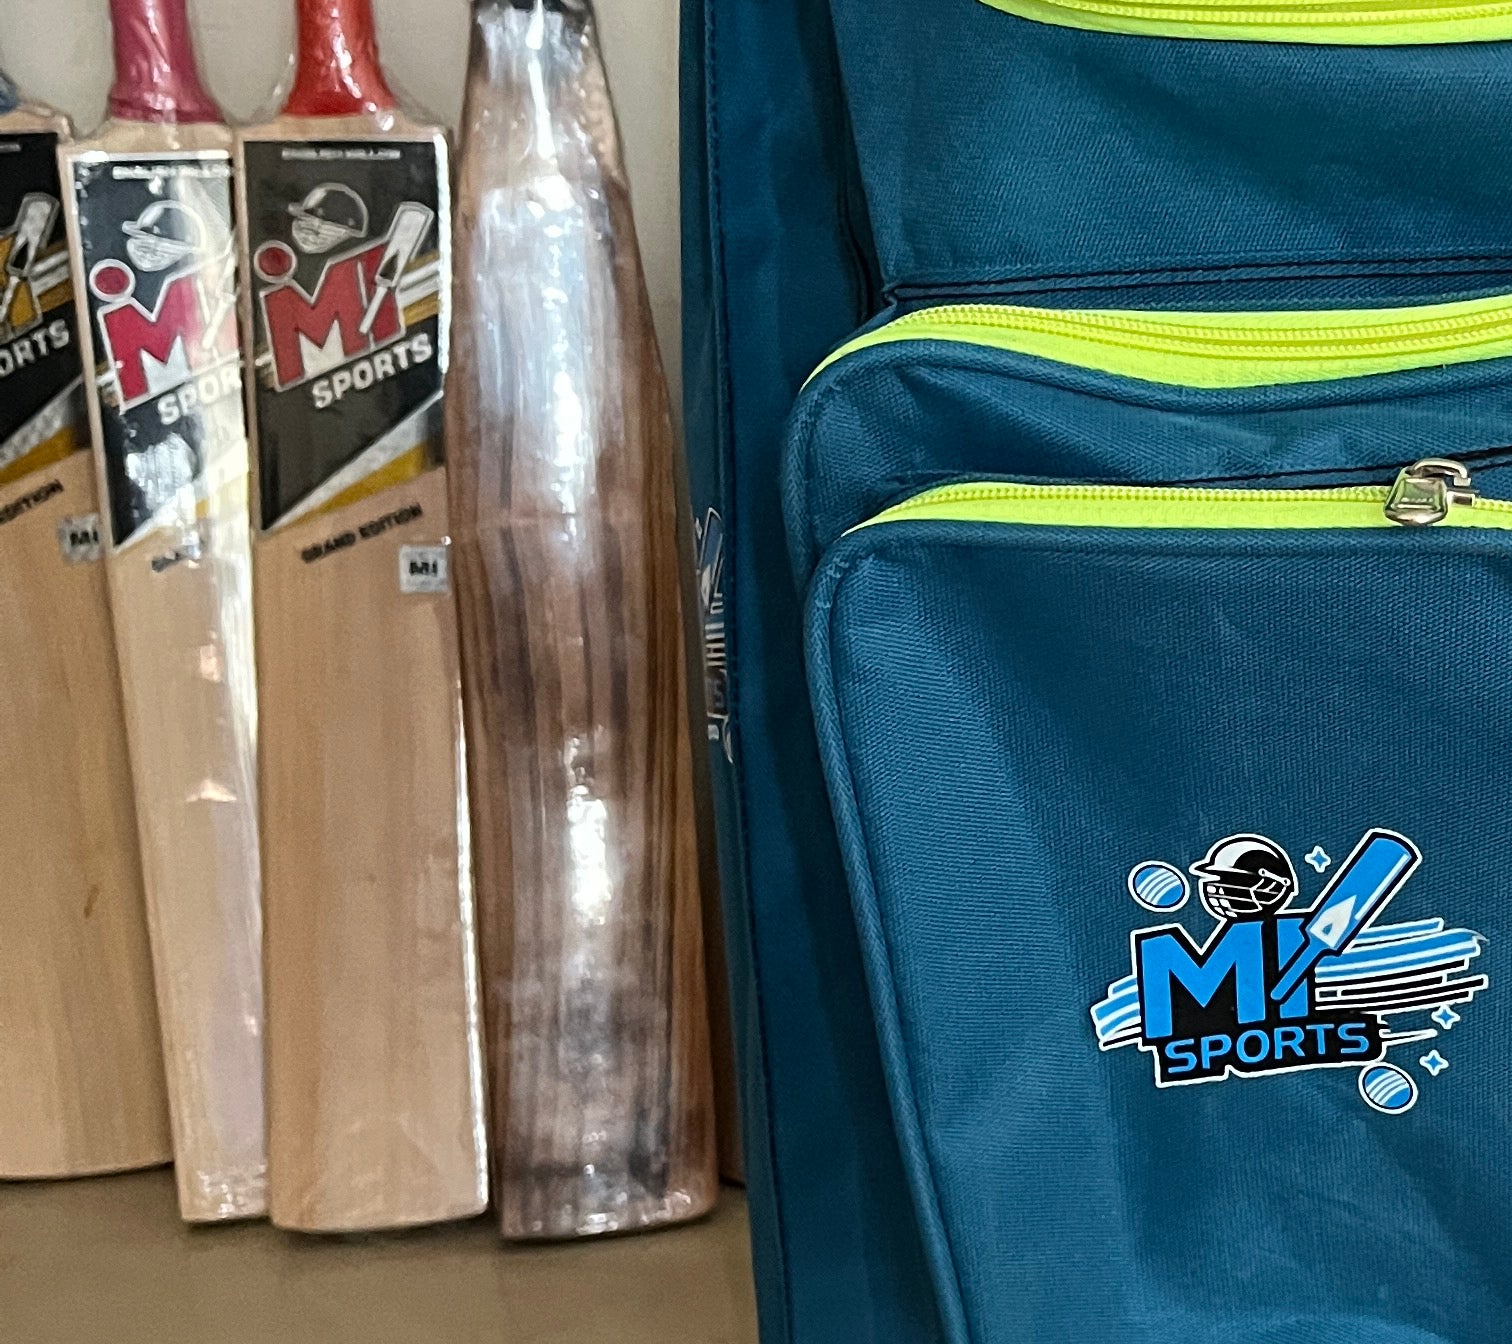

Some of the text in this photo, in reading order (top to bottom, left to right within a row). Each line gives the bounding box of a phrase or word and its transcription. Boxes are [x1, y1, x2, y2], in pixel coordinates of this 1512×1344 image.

[0, 318, 69, 377] ORTS
[312, 333, 432, 408] SPORTS
[158, 363, 242, 425] SPOR
[408, 559, 438, 576] MI
[1165, 1022, 1370, 1074] SPORTS
